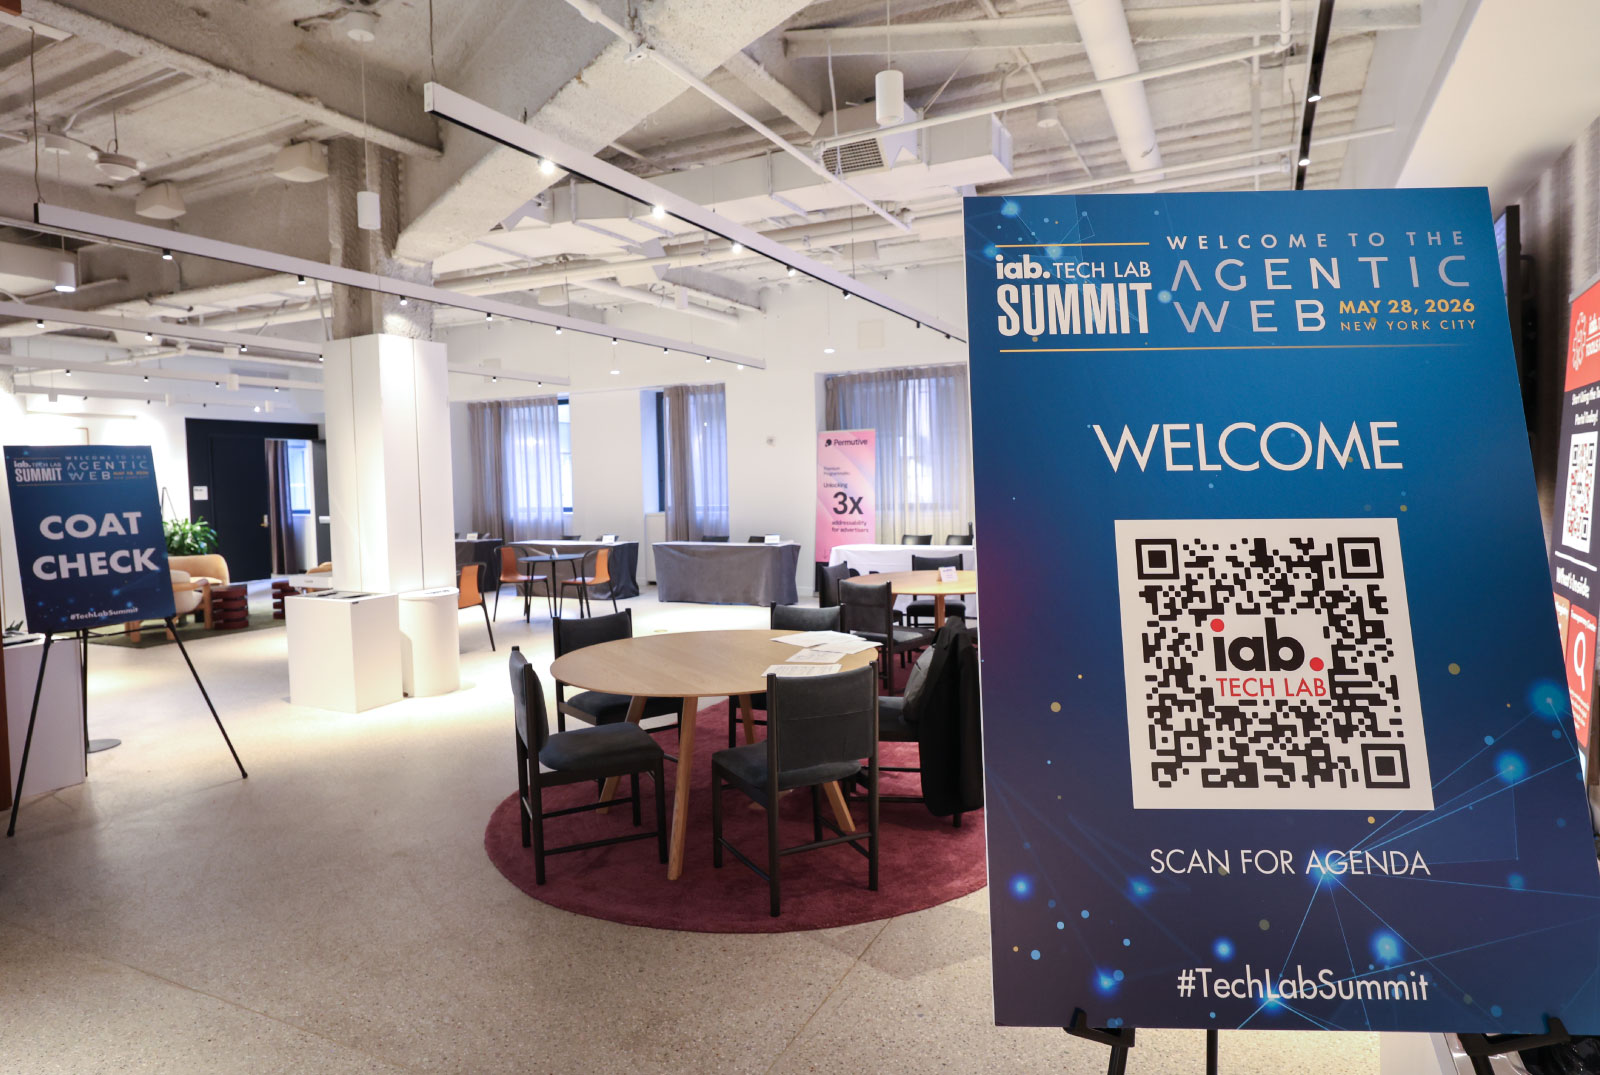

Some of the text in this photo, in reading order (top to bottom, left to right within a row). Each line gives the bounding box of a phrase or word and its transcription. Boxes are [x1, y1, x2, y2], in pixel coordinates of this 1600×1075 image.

[1166, 231, 1464, 250] WELCOME TO THE
[995, 254, 1151, 280] iab. TECH LAB
[1171, 255, 1470, 292] AGENTIC
[996, 282, 1153, 337] SUMMIT
[1172, 300, 1326, 333] WEB
[1339, 298, 1476, 316] MAY 28, 2026
[1340, 319, 1477, 332] NEW YORK CITY
[833, 439, 868, 447] Permutive
[1092, 420, 1404, 473] WELCOME
[14, 467, 62, 483] SUMMIT
[67, 460, 150, 471] AGENTIC
[68, 471, 111, 481] WEB
[832, 491, 864, 515] 3x
[39, 511, 142, 540] COAT
[32, 547, 160, 581] CHECK
[70, 607, 139, 620] #TechLabSummit
[1210, 617, 1325, 672] iab.
[1216, 677, 1327, 697] TECH LAB
[1150, 849, 1431, 876] SCAN FOR AGENDA
[1177, 964, 1429, 1001] #TechLabSummit
